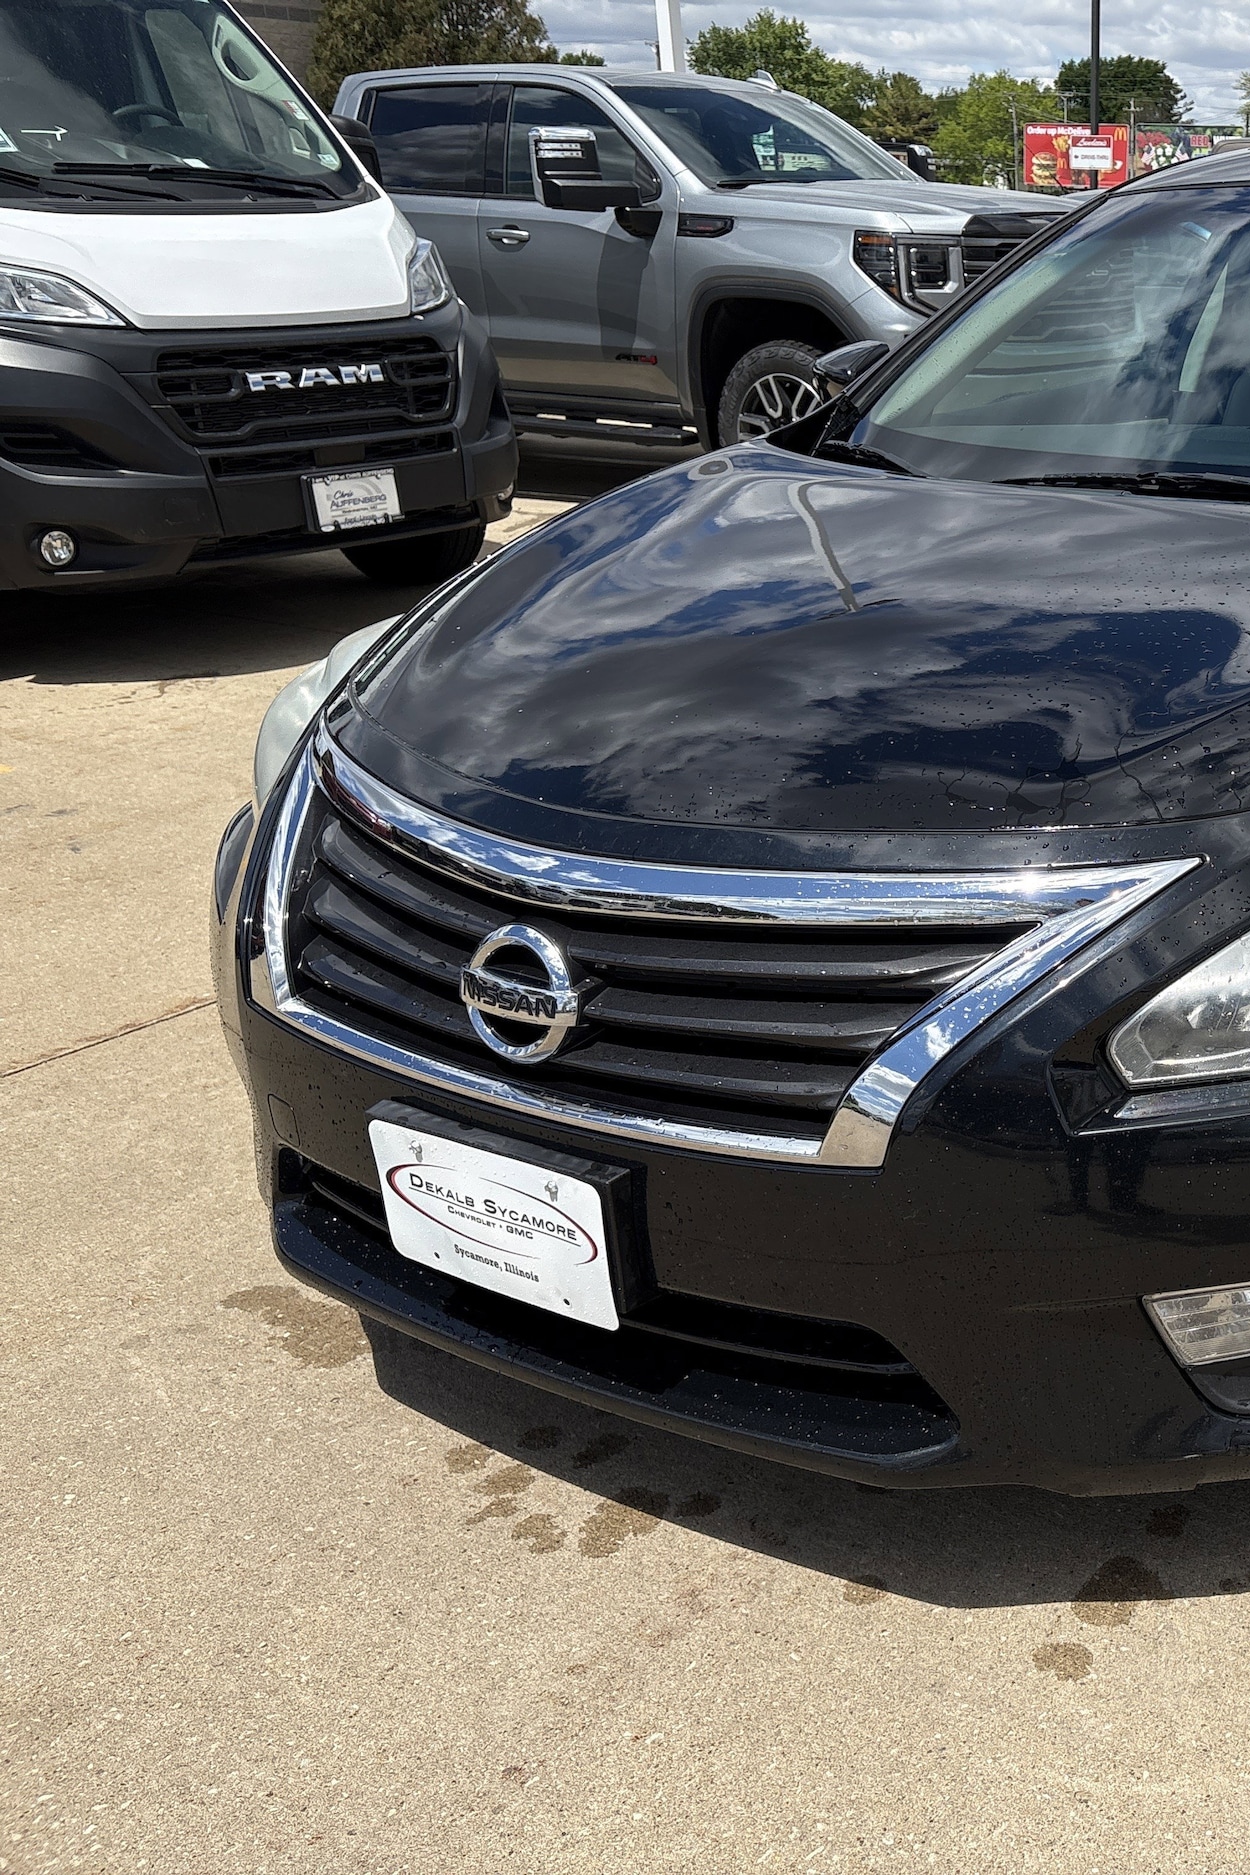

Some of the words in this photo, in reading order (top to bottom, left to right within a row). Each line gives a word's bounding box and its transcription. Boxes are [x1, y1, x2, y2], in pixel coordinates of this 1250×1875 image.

[1027, 126, 1047, 135] Order
[1047, 128, 1057, 136] up
[1057, 126, 1091, 135] McDelive
[245, 364, 385, 392] RAM
[333, 490, 354, 500] Chris
[462, 972, 558, 1018] NISSAN
[447, 1205, 496, 1229] CHEVROLET
[506, 1225, 534, 1240] GMC
[484, 1199, 577, 1241] SYCAMORE
[454, 1244, 503, 1272] Sycamore,
[504, 1261, 540, 1283] Illinois
